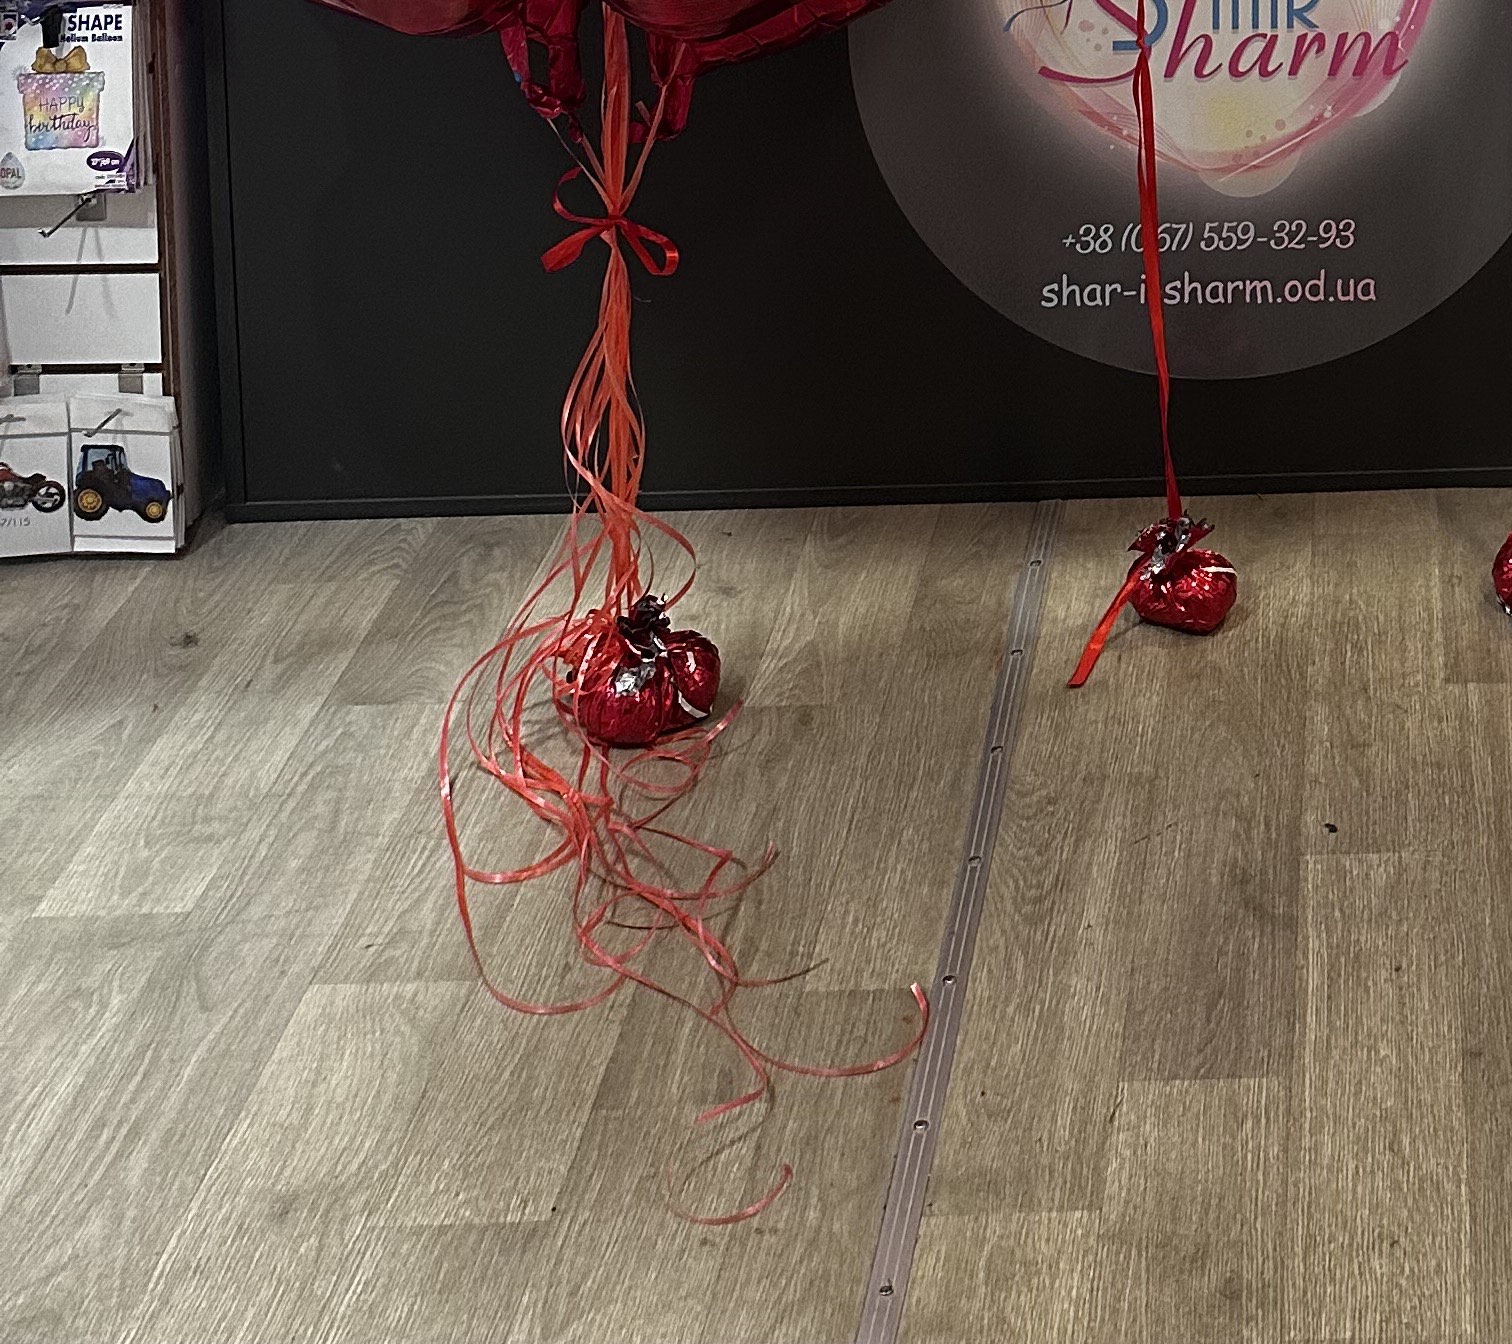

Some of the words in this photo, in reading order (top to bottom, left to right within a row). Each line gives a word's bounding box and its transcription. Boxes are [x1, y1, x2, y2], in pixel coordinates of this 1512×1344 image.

[67, 14, 123, 31] SHAPE
[26, 112, 99, 142] birthday
[1061, 223, 1114, 254] +38
[1200, 218, 1356, 251] 559-32-93
[1040, 268, 1377, 308] shar-isharm.od.ua
